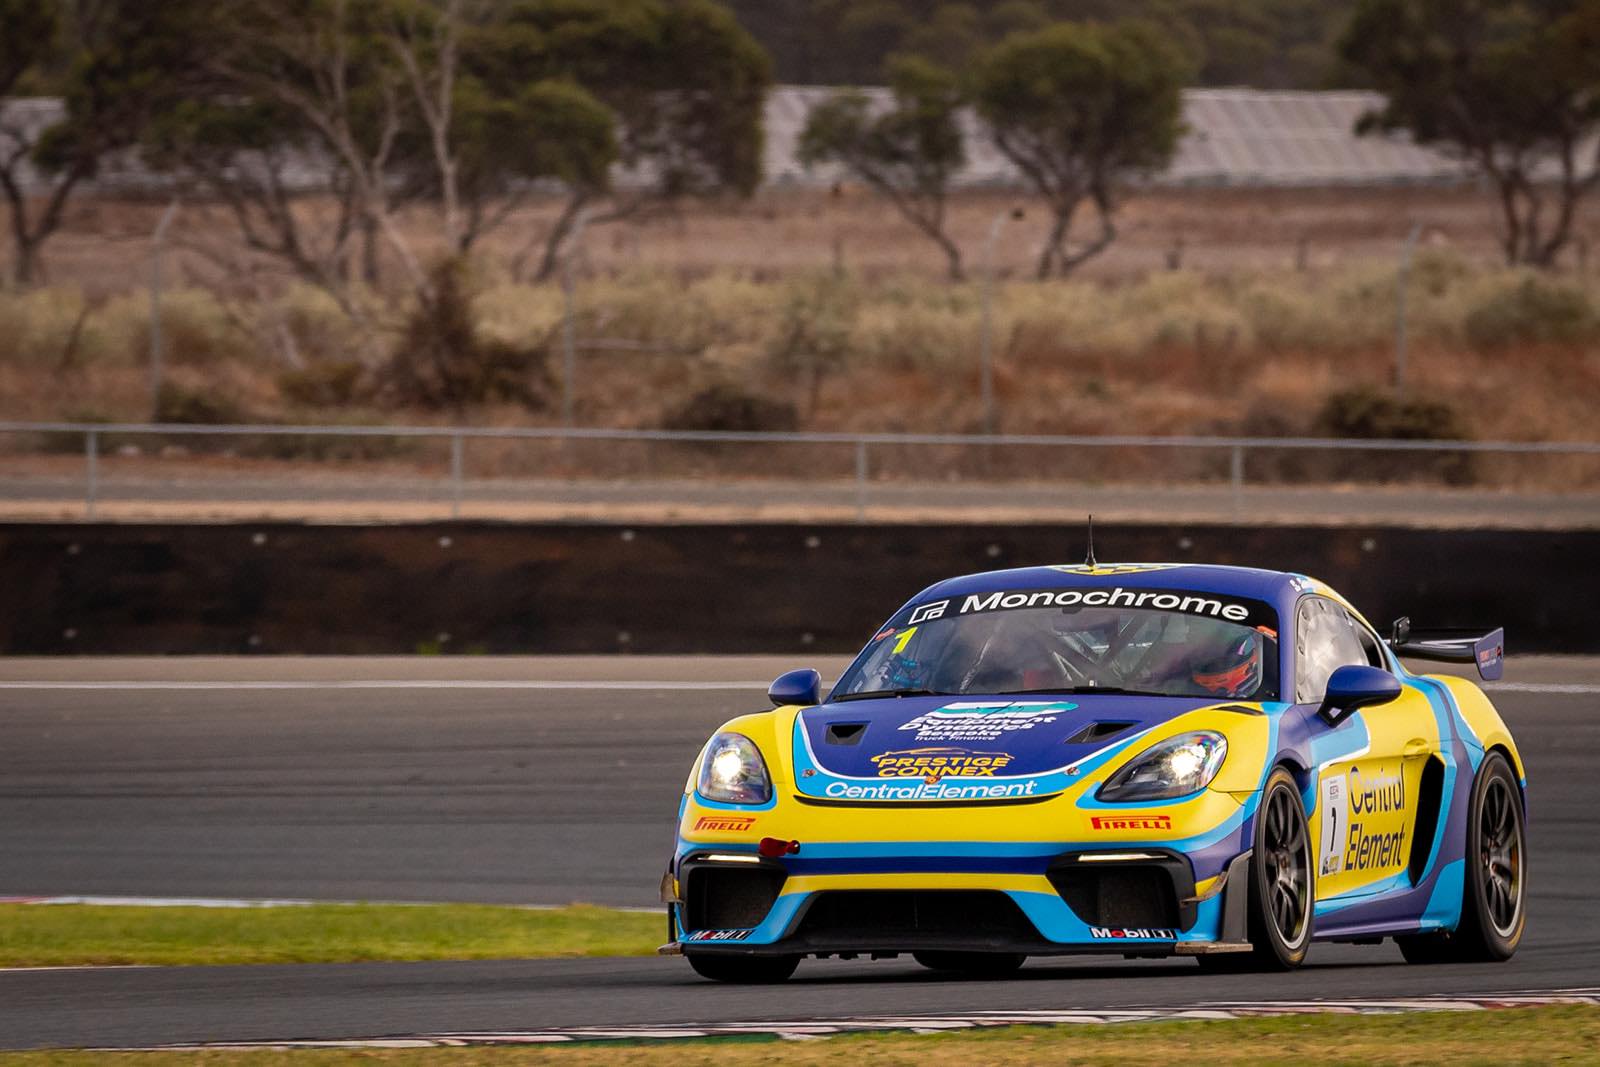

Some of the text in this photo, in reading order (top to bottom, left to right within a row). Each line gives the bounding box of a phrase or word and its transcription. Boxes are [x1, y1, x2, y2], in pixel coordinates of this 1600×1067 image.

[959, 587, 1250, 622] Monochrome
[892, 626, 918, 655] 1
[897, 722, 1035, 732] Dynamics
[877, 757, 1011, 768] PRESTIGE
[878, 767, 997, 778] CONNEX
[1350, 763, 1406, 815] Central
[693, 816, 756, 831] PIRELLI
[1091, 815, 1171, 830] PIRELLI
[1345, 823, 1405, 871] Element
[689, 930, 733, 942] Mobil
[1091, 928, 1151, 939] Mobil
